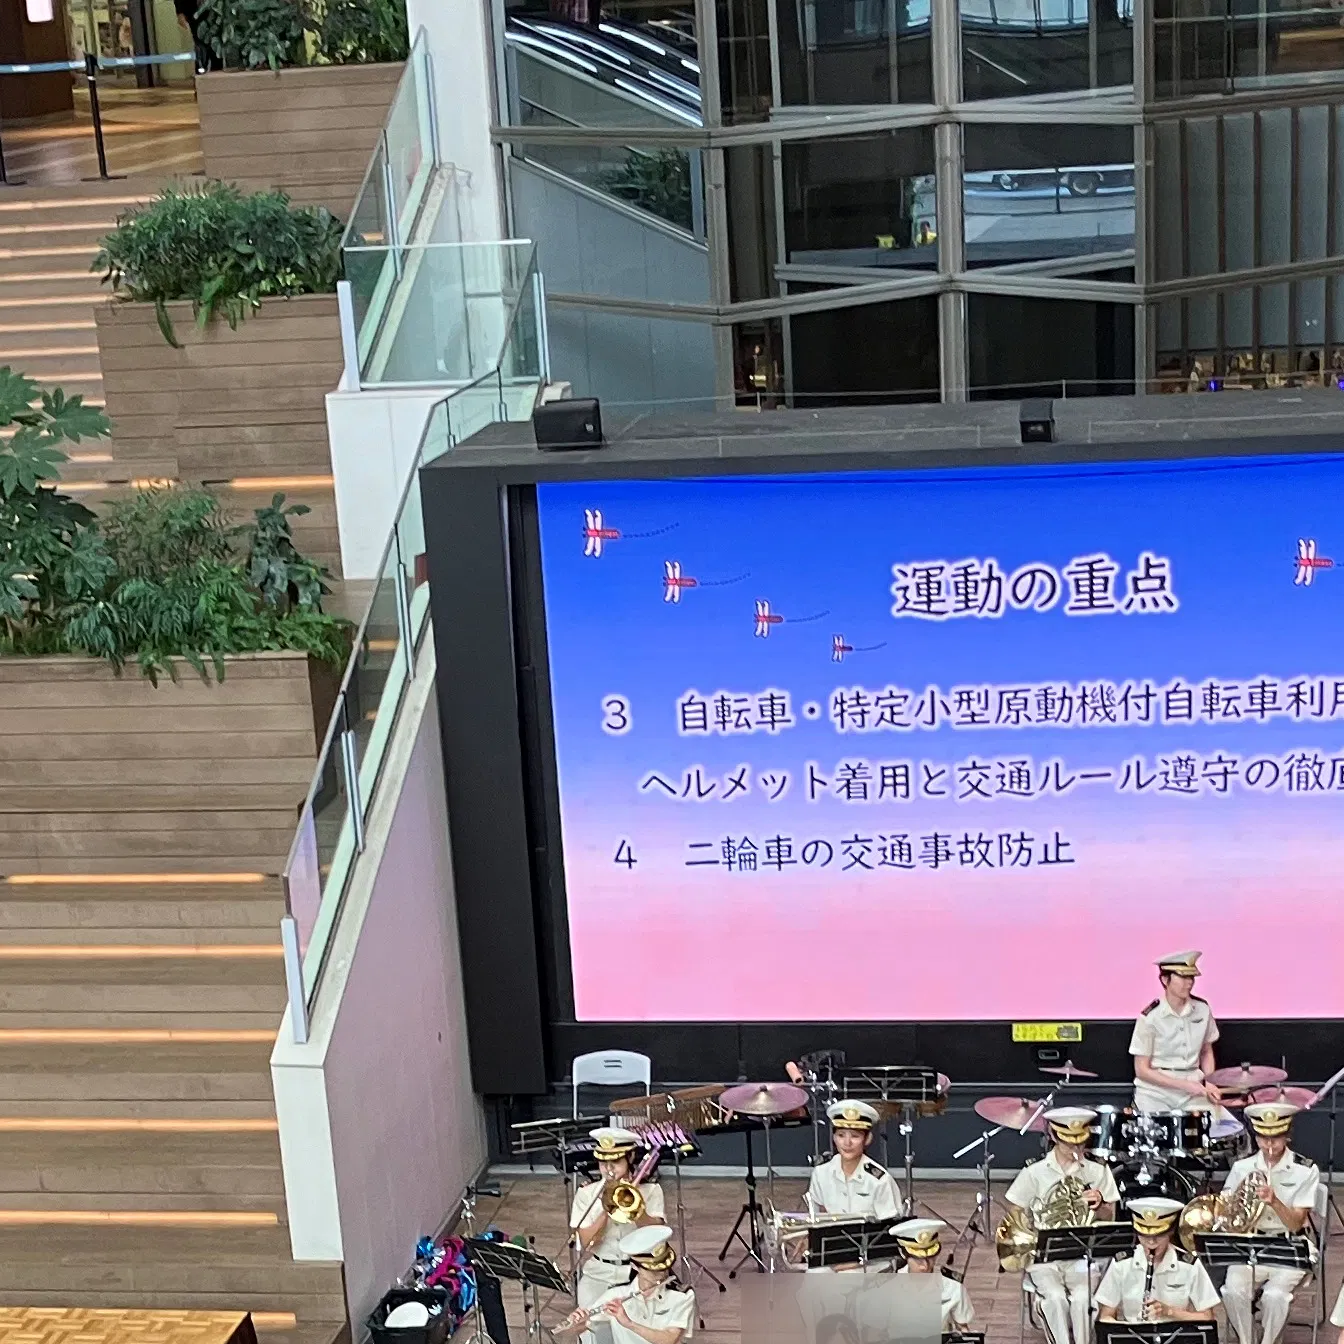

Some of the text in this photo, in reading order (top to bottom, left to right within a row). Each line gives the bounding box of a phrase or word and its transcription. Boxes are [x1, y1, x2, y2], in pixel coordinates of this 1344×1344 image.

[894, 553, 1177, 617] 運動の重点
[604, 698, 628, 730] 3
[613, 831, 1077, 872] 4 二輪車の交通事故防止
